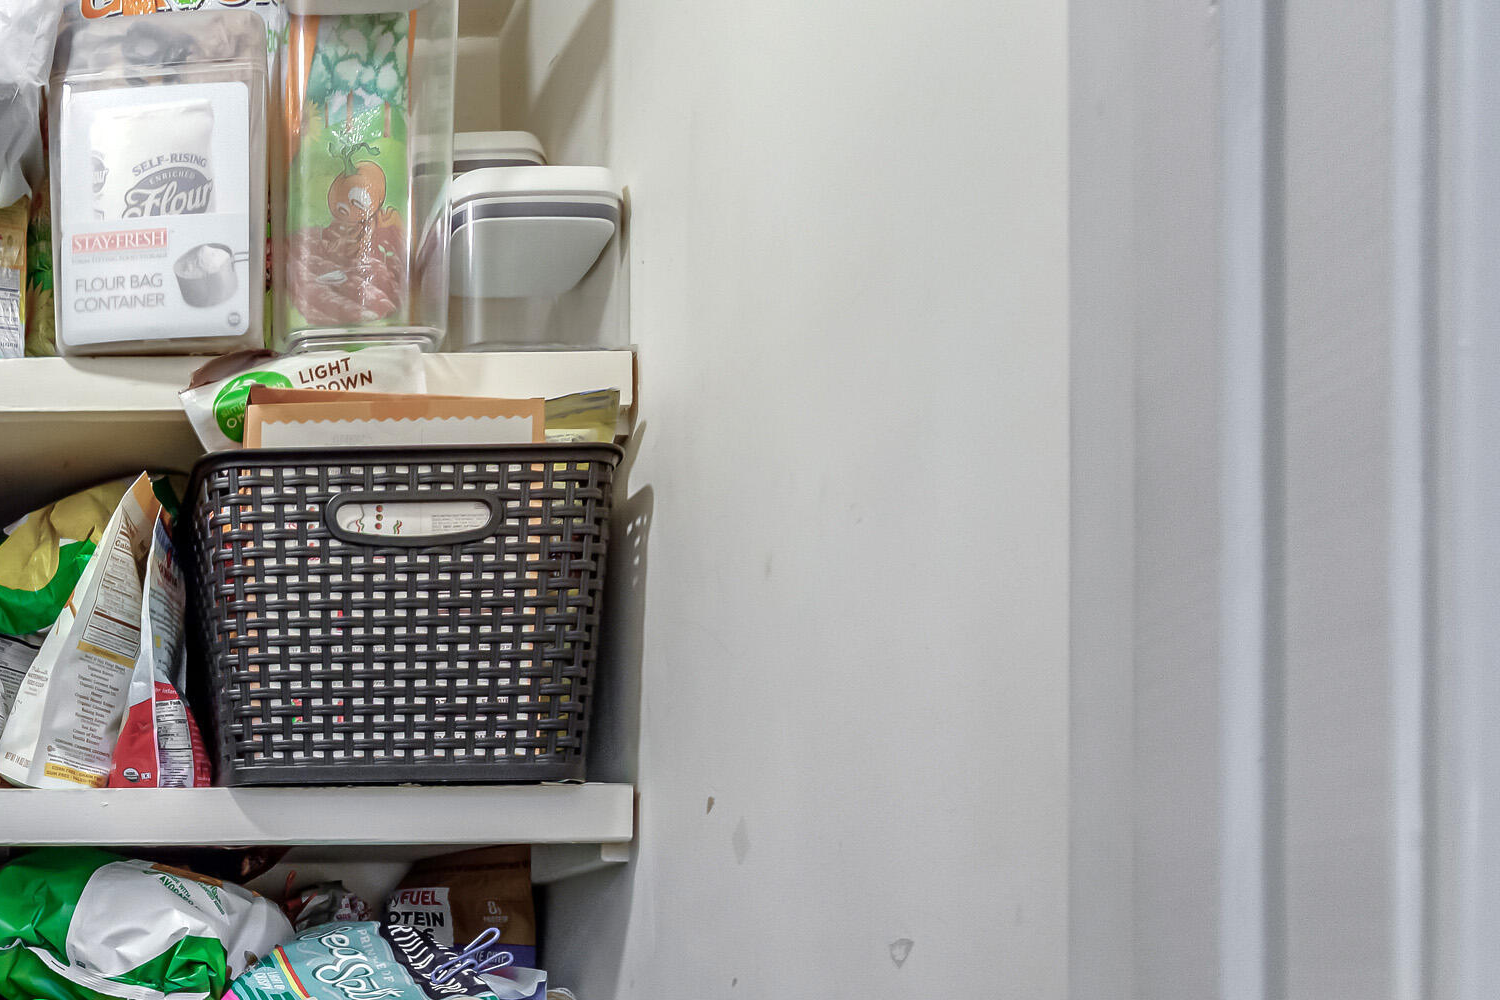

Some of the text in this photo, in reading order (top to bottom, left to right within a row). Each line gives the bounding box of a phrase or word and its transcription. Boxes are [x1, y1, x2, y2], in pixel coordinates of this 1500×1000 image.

[132, 153, 207, 177] SELF-RISING
[123, 179, 213, 218] Flour
[75, 273, 163, 293] FLOUR BAG
[74, 293, 165, 313] CONTAINER
[299, 357, 351, 384] LIGHT
[387, 911, 444, 928] OTEIN
